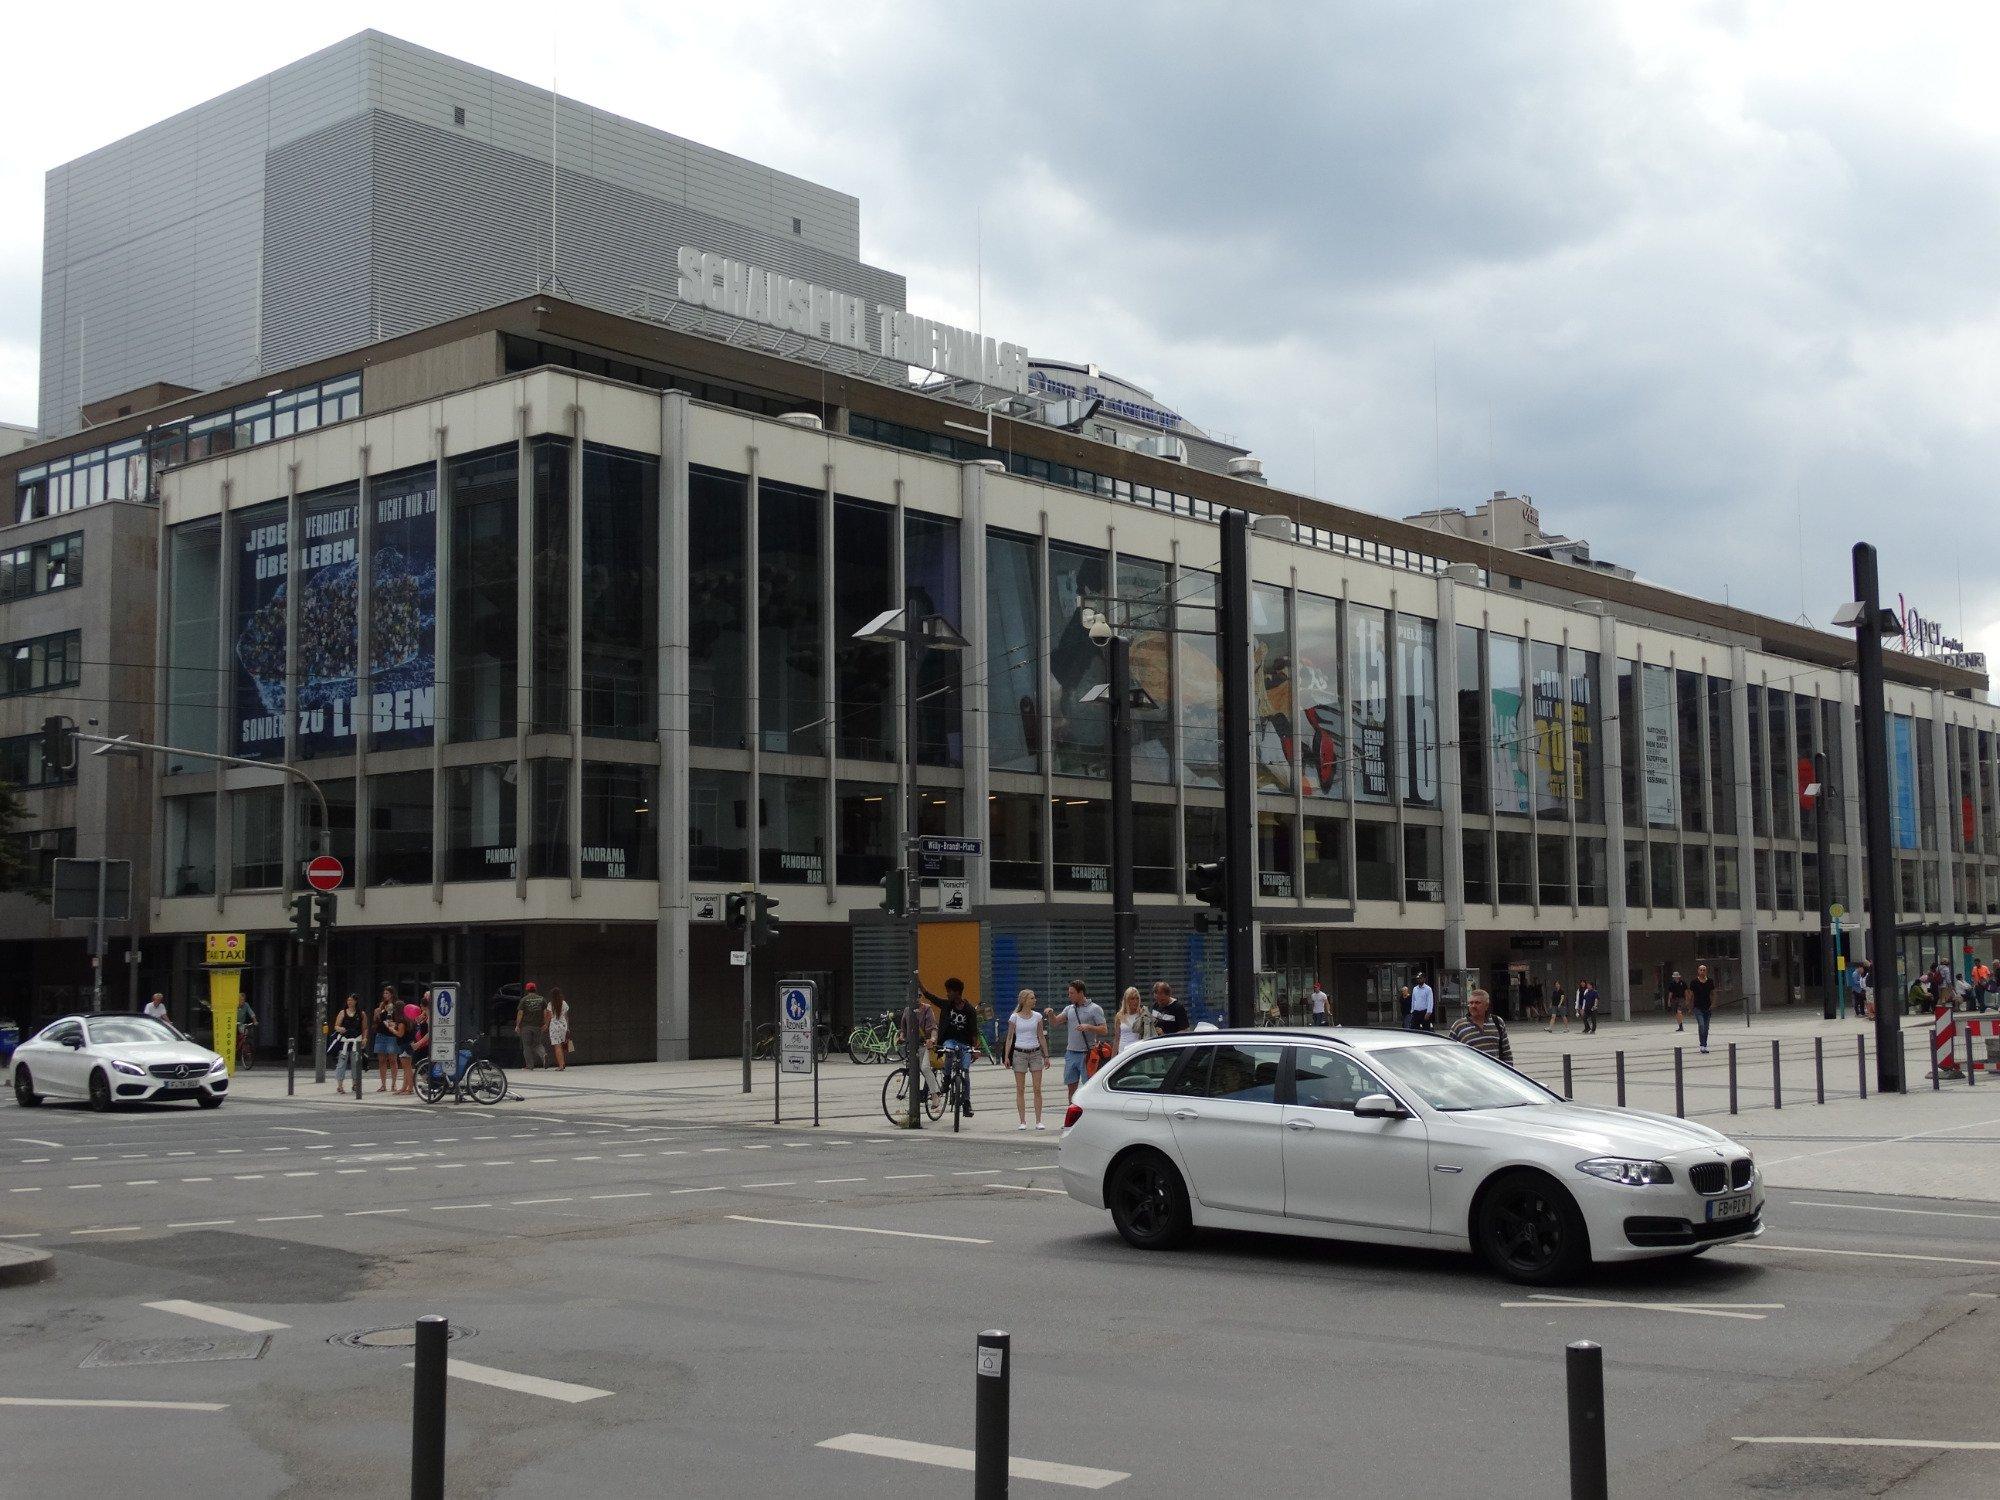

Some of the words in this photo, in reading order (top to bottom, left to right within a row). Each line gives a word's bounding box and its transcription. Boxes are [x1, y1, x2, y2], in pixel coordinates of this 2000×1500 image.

[678, 246, 870, 350] SCHAUSPIEL
[306, 508, 350, 538] VERDIENT
[378, 497, 402, 523] NICHT
[406, 493, 422, 517] NUR
[426, 489, 436, 513] ZU
[1908, 606, 1941, 651] Oper
[243, 714, 286, 743] SONDER
[300, 709, 324, 735] ZU
[928, 841, 976, 852] Willy-Brandt-Platz
[781, 855, 821, 869] PANORAMA
[1071, 866, 1107, 879] SCHAUSPIEL
[1262, 875, 1291, 886] SCHAUSPIEL
[219, 950, 245, 960] TAXI
